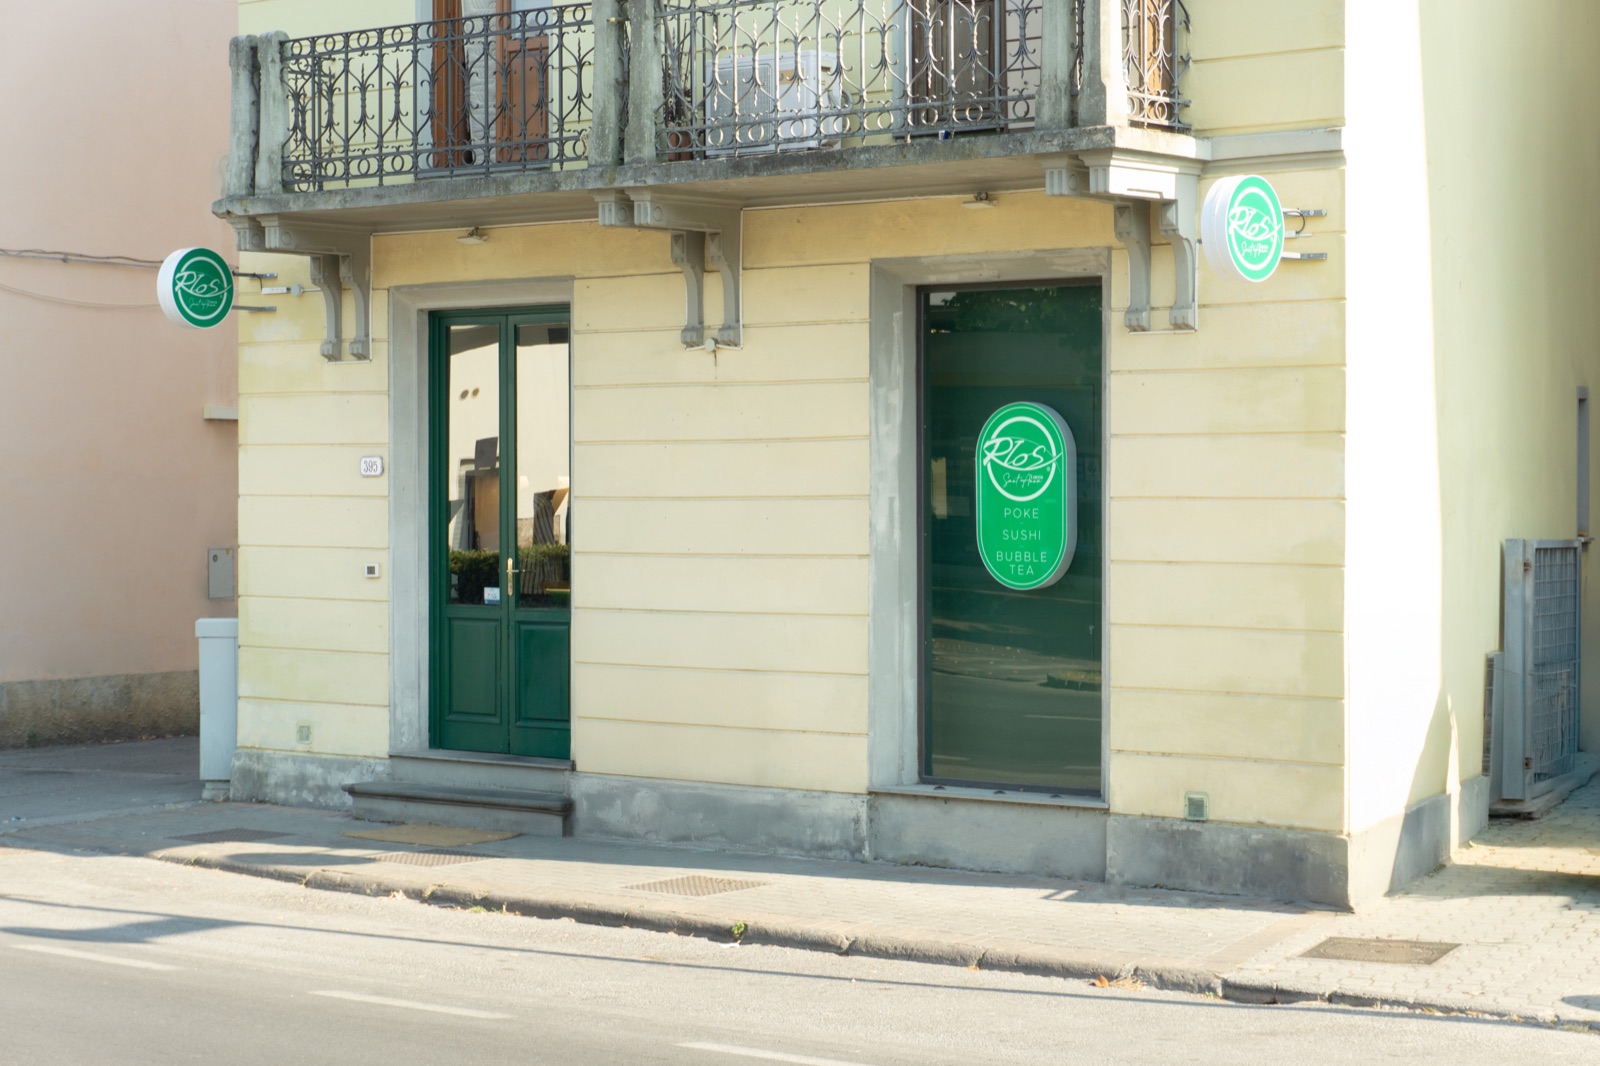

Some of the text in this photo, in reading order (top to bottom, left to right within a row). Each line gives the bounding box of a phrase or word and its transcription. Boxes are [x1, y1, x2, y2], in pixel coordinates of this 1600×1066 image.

[363, 459, 378, 473] 395
[1003, 507, 1039, 519] POKE
[1002, 529, 1041, 541] SUSHI
[996, 550, 1048, 562] BUBBLE
[1009, 564, 1035, 576] TEA
